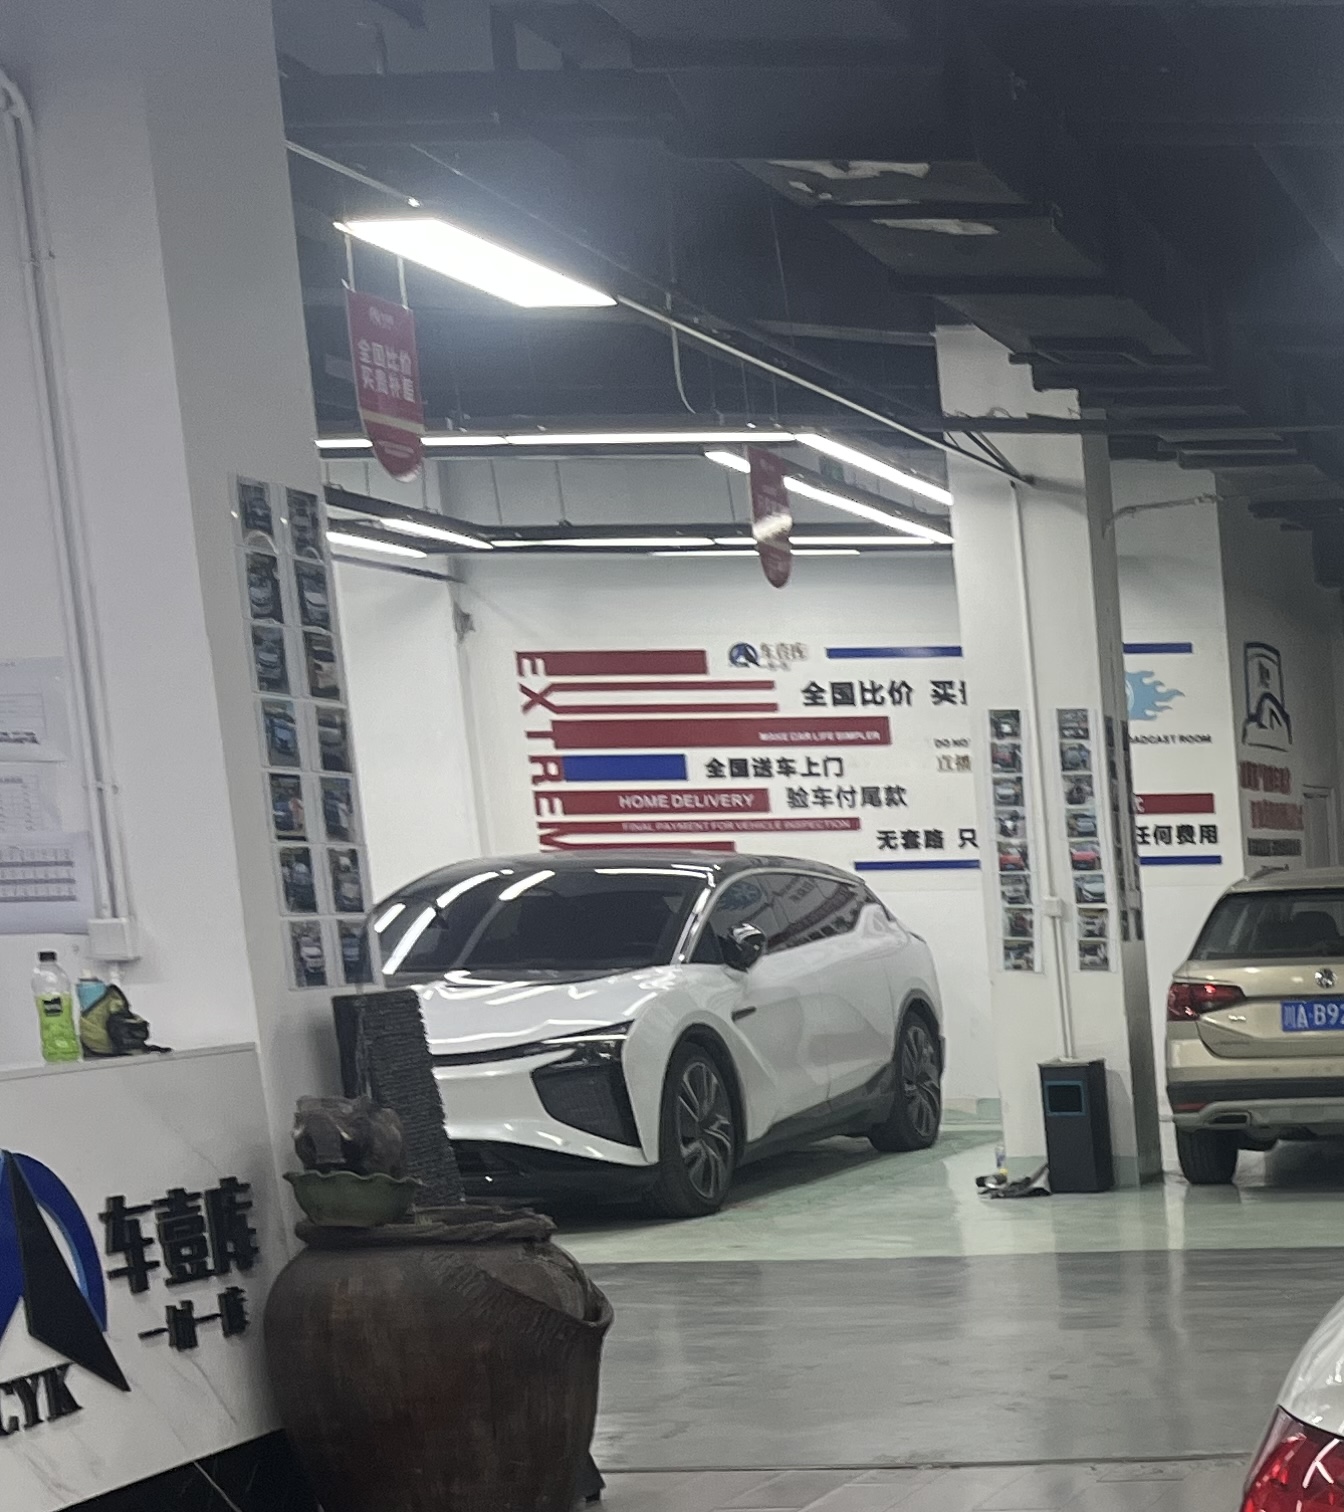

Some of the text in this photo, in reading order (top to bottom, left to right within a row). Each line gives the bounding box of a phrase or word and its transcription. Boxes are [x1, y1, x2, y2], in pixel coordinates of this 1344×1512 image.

[801, 680, 913, 706] 全国比价
[705, 756, 845, 778] 全国送车上门
[618, 793, 753, 809] HOME DELIVERY
[786, 786, 907, 809] 验车付尾款
[710, 821, 734, 830] FOR
[876, 829, 944, 850] 无套路
